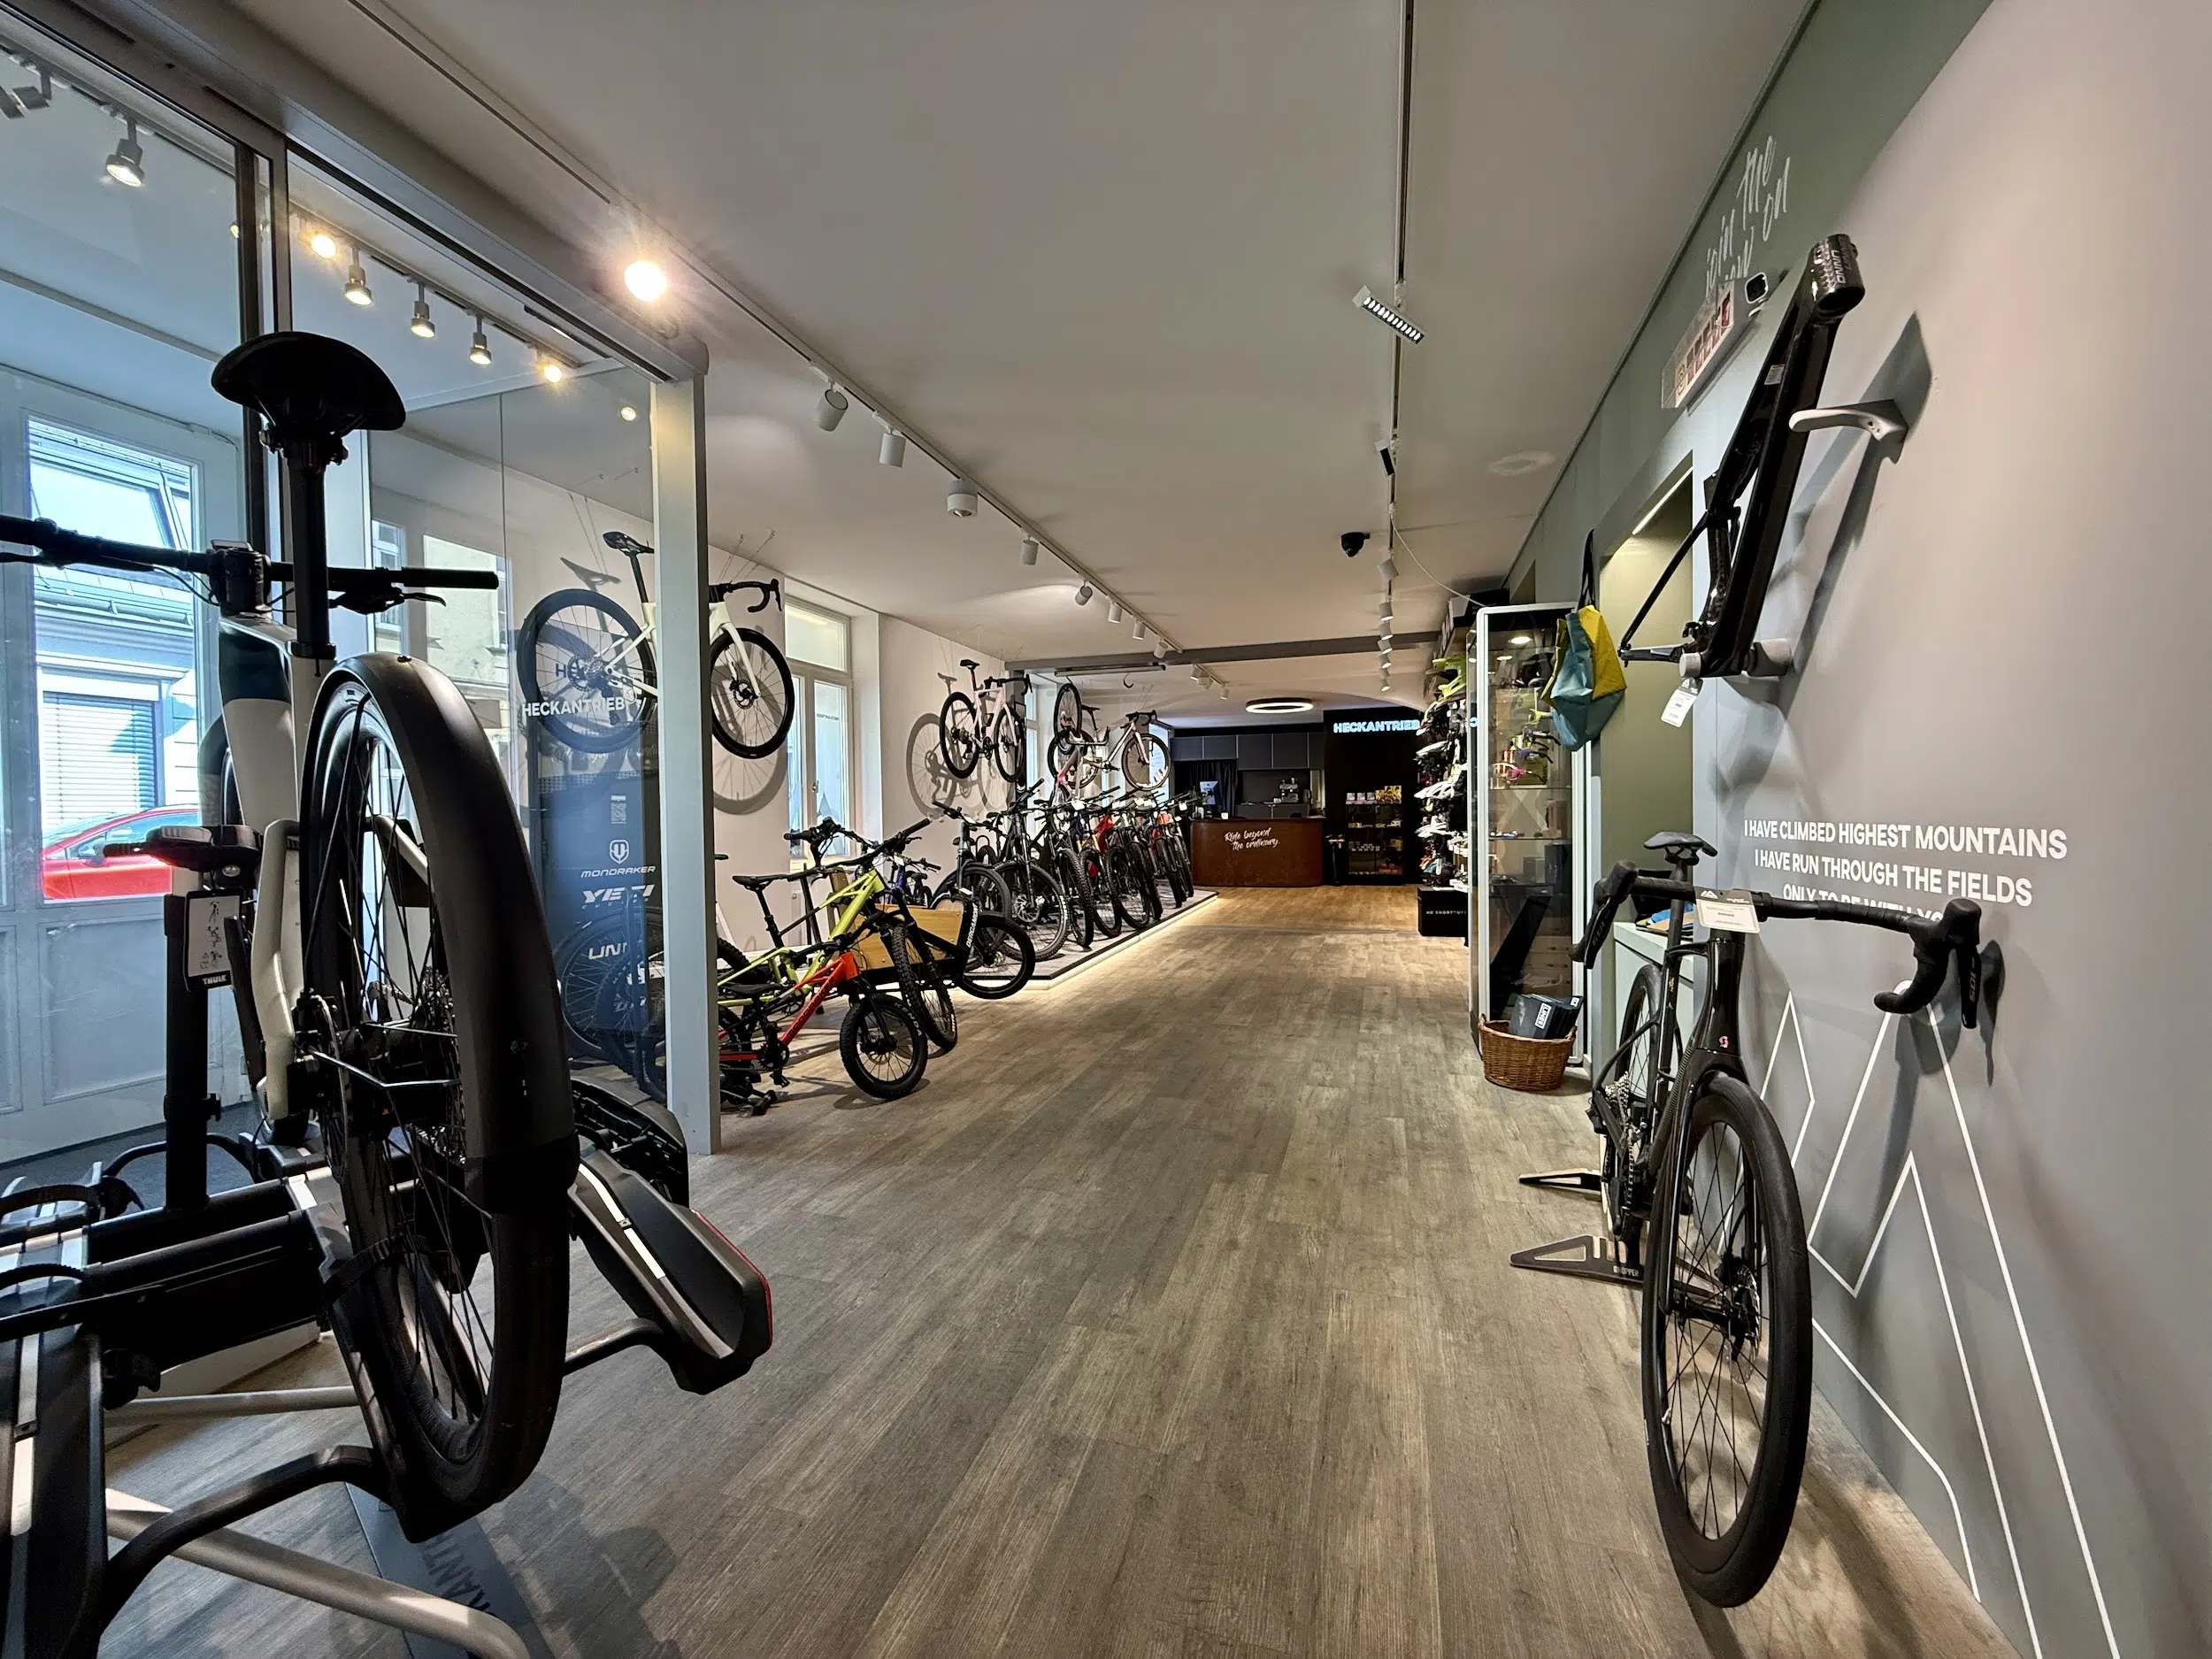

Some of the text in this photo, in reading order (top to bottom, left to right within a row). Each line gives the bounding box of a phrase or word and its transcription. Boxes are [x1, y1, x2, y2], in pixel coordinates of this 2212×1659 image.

[1831, 250, 1847, 284] UNNO
[521, 695, 626, 718] HECKANTRIEB
[1333, 719, 1421, 733] HECKANTRIEB
[1224, 827, 1271, 842] Ride beyond
[1744, 819, 2068, 859] I HAVE CLIMBED HIGHEST MOUNTAINS
[580, 865, 657, 879] MONDRAKER
[1755, 849, 2032, 907] I HAVE RUN THROUGH THE FIELDS
[582, 884, 655, 903] YETI
[202, 974, 227, 985] THULE
